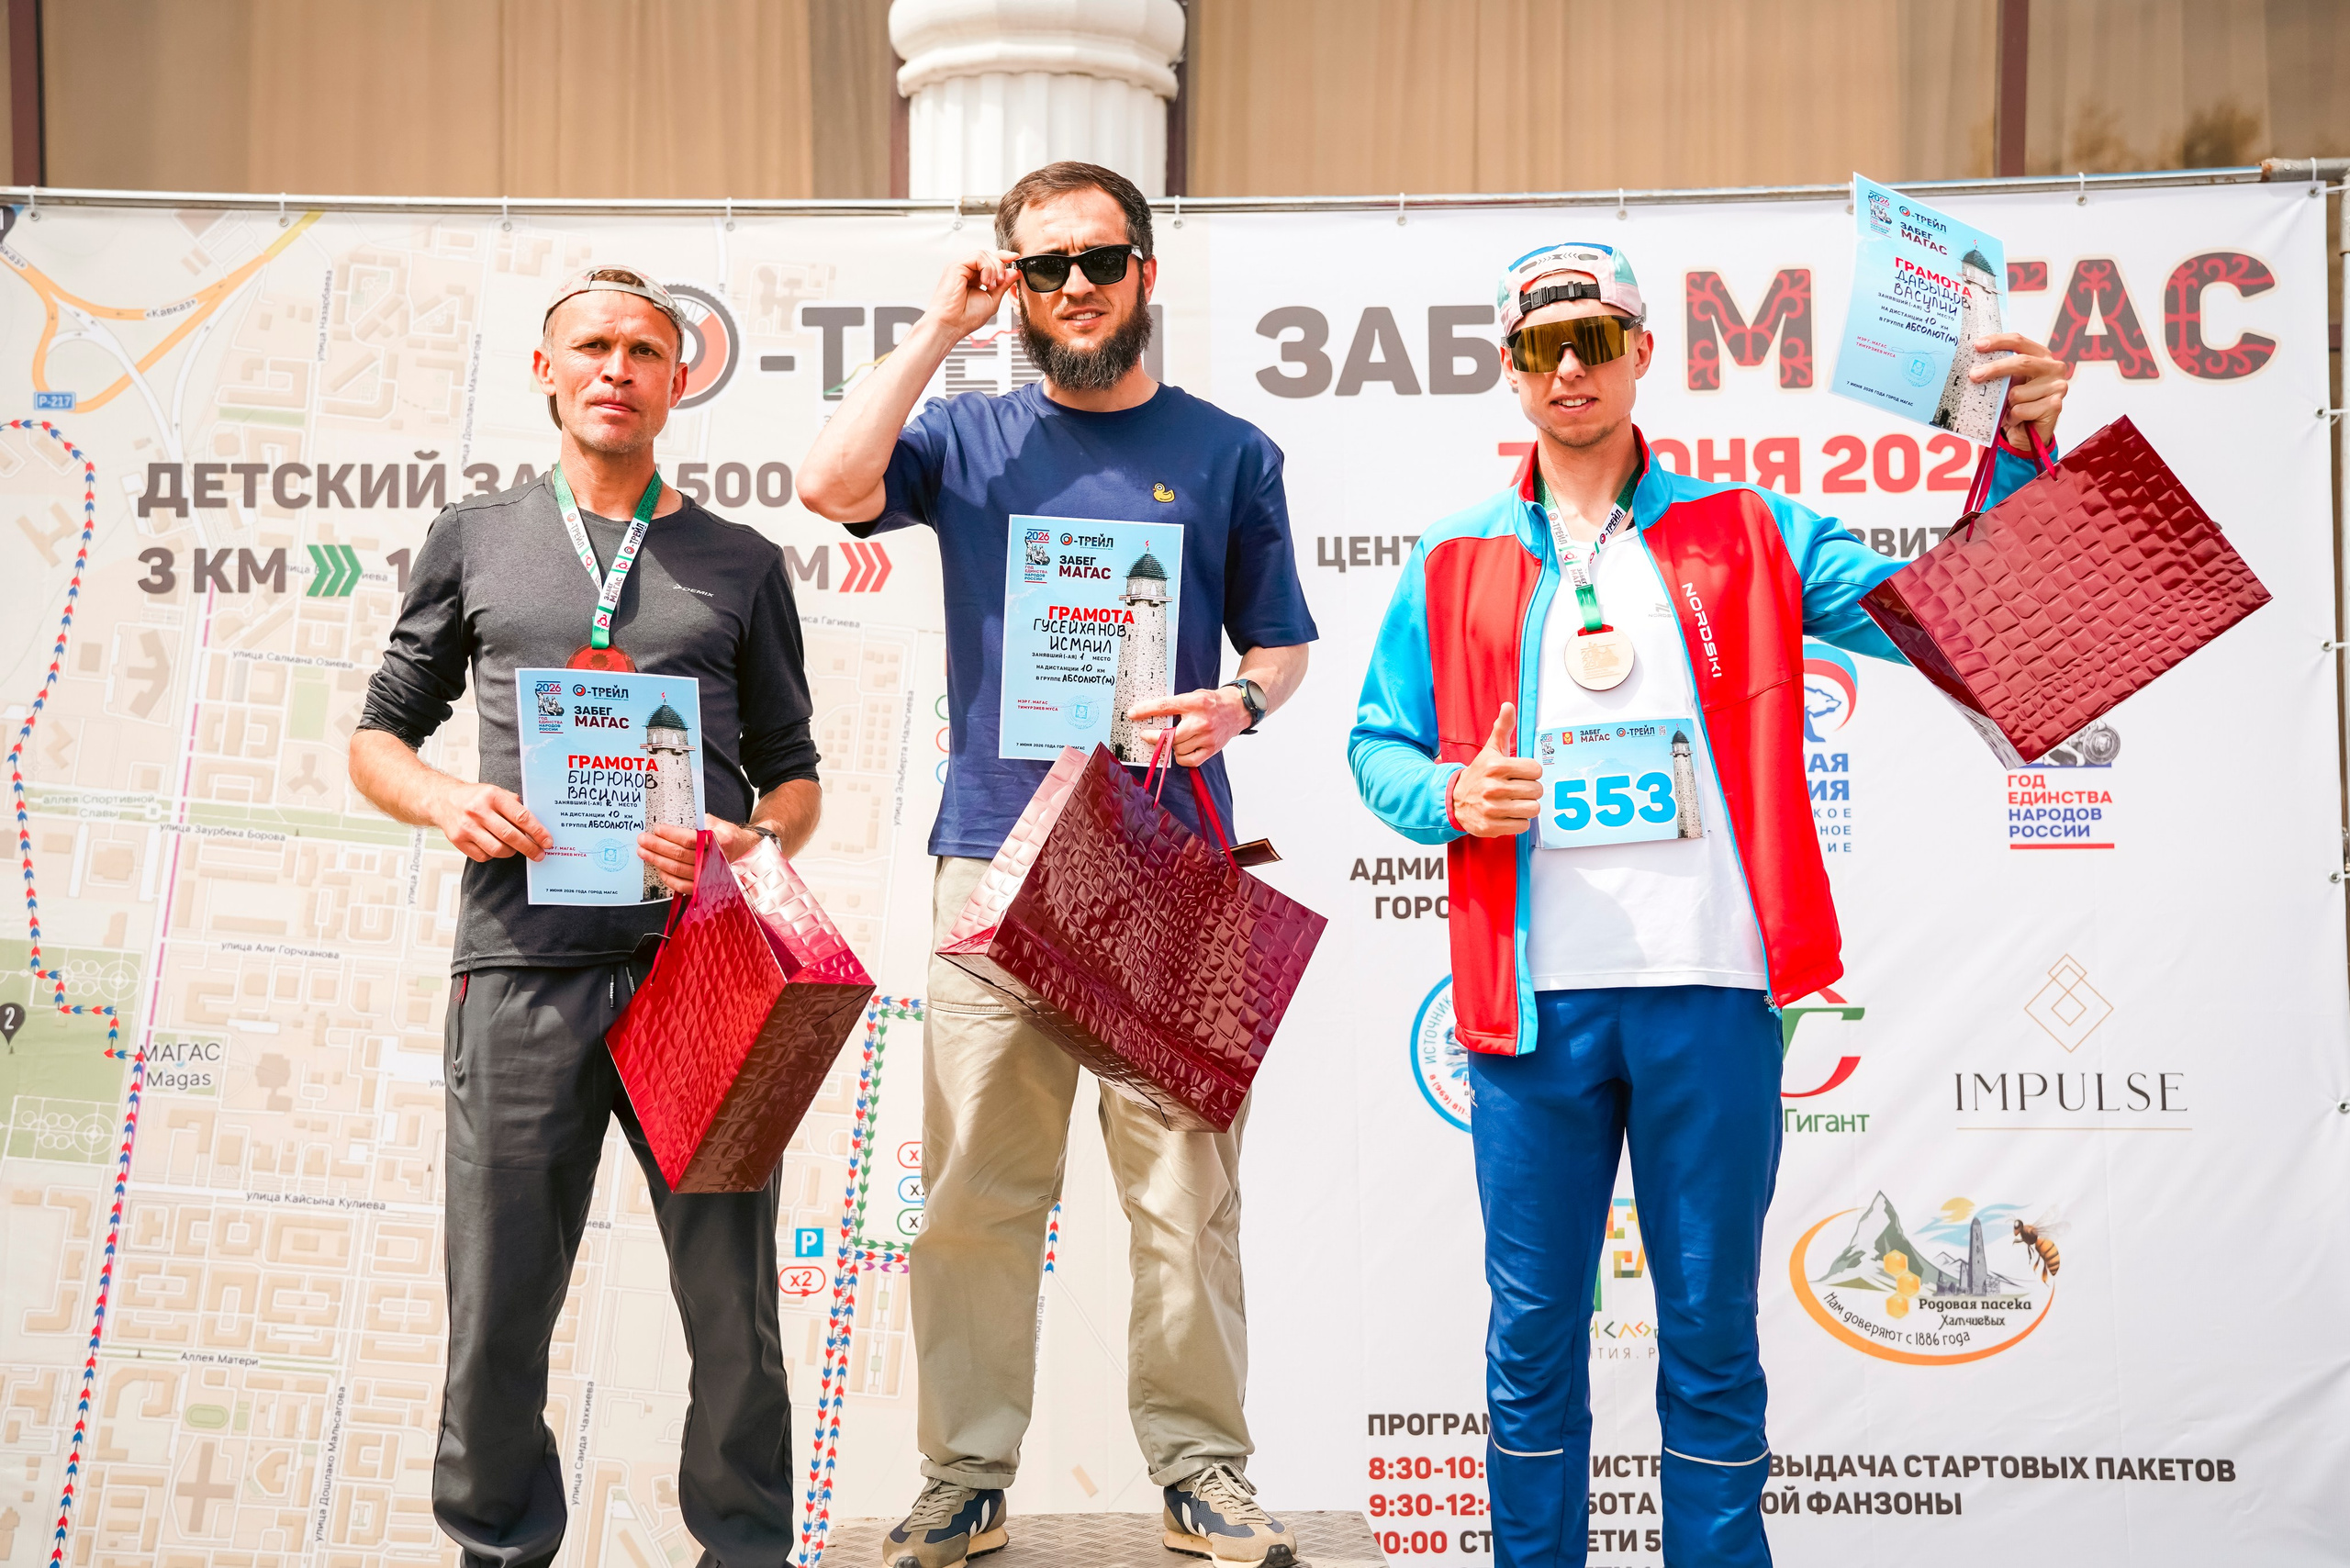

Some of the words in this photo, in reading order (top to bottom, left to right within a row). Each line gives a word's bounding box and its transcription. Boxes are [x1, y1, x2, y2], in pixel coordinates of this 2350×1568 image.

[1900, 221, 1933, 241] ЗАБЕГ
[1900, 230, 1948, 255] МАГАС
[1895, 256, 1973, 298] ГРАМОТА
[1895, 269, 1972, 310] ДАВЫДОВ
[319, 270, 333, 330] Назарбаева
[1878, 292, 1908, 306] ЗАНЯВШИЙ
[1936, 312, 1955, 321] МЕСТО
[1894, 283, 1958, 317] ВАСИЛИЙ
[1256, 304, 1504, 398] ЗАБ
[1686, 251, 2277, 391] МАС
[1883, 318, 1905, 328] ГРУППЕ
[1889, 308, 1923, 323] ДИСТАНЦИИ
[1925, 317, 1937, 326] 10
[318, 332, 326, 362] улица
[468, 333, 483, 394] Мальсагова
[463, 398, 476, 441] Дошлако
[1822, 433, 1985, 494] 202
[138, 450, 447, 518] ДЕТСКИЙ
[677, 462, 792, 508] 500
[1026, 531, 1050, 541] 2026
[138, 547, 176, 595] 3
[194, 548, 286, 594] КМ
[783, 545, 830, 590] М
[1059, 554, 1097, 566] ЗАБЕГ
[1058, 565, 1112, 579] МАГАС
[603, 582, 614, 601] ЗАБЕГ
[610, 577, 623, 603] МАГАС
[682, 587, 715, 598] DEMIX
[822, 616, 861, 630] Гагиева
[1048, 605, 1136, 624] ГРАМОТА
[1033, 618, 1127, 638] ГУСЕЙХАНОВ
[1682, 582, 1722, 678] NORDSKI
[1050, 635, 1113, 654] ИСМАИЛ
[232, 650, 263, 662] улица
[267, 651, 313, 666] Салмана
[316, 656, 354, 670] Озиева
[1080, 653, 1085, 661] 1
[1080, 664, 1093, 673] 10
[536, 683, 562, 693] 2026
[574, 705, 613, 716] ЗАБЕГ
[901, 690, 915, 744] Нальгиева
[575, 715, 630, 729] МАГАС
[1580, 728, 1601, 736] ЗАБЕГ
[1581, 734, 1611, 744] МАГАС
[568, 755, 659, 771] ГРАМОТА
[895, 746, 909, 794] Эльберта
[567, 770, 659, 790] БИРЮКОВ
[2008, 775, 2046, 790] ГОД
[43, 795, 79, 806] аллея
[83, 793, 156, 807] Спортивной
[567, 786, 642, 803] ВАСИЛИЙ
[1554, 772, 1677, 831] 553
[2008, 790, 2113, 806] ЕДИНСТВА
[79, 808, 119, 820] Славы
[608, 810, 621, 819] 10
[892, 796, 903, 826] улица
[2009, 807, 2103, 823] НАРОДОВ
[160, 823, 193, 835] улица
[195, 826, 245, 840] Заурбека
[247, 830, 286, 842] Борова
[2009, 824, 2091, 838] РОССИИ
[408, 875, 419, 905] улица
[221, 942, 252, 955] улица
[256, 944, 275, 955] Али
[278, 946, 341, 961] Горчханова
[4, 1006, 16, 1030] 2
[1423, 995, 1453, 1065] ИСТОЧНИК
[140, 1043, 221, 1063] МАГАС
[146, 1070, 212, 1091] Magas
[1955, 1071, 2188, 1112] IMPULSE
[1785, 1109, 1870, 1134] Гигант
[246, 1191, 281, 1204] улица
[285, 1193, 336, 1208] Кайсына
[339, 1197, 387, 1211] Кулиева
[801, 1231, 818, 1255] P
[1919, 1297, 1977, 1313] Родовая
[1981, 1297, 2032, 1310] пасека
[1823, 1292, 1843, 1316] Нам
[1844, 1311, 1904, 1342] доверяют
[1906, 1334, 1912, 1345] с
[1915, 1331, 1940, 1346] 1886
[1942, 1331, 1971, 1348] года
[1939, 1314, 2006, 1330] Хамчиевых
[181, 1350, 215, 1365] Аллея
[218, 1354, 260, 1367] Матери
[328, 1386, 347, 1452] Мальсагова
[1369, 1456, 1484, 1480] 8:30-10:
[1770, 1454, 1896, 1481] ВЫДАЧА
[1904, 1454, 2090, 1480] СТАРТОВЫХ
[2097, 1456, 2237, 1483] ПАКЕТОВ
[319, 1454, 336, 1504] Дошлако
[1370, 1493, 1491, 1517] 9:30-12:
[1807, 1491, 1963, 1516] ФАНЗОНЫ
[314, 1508, 329, 1541] улица
